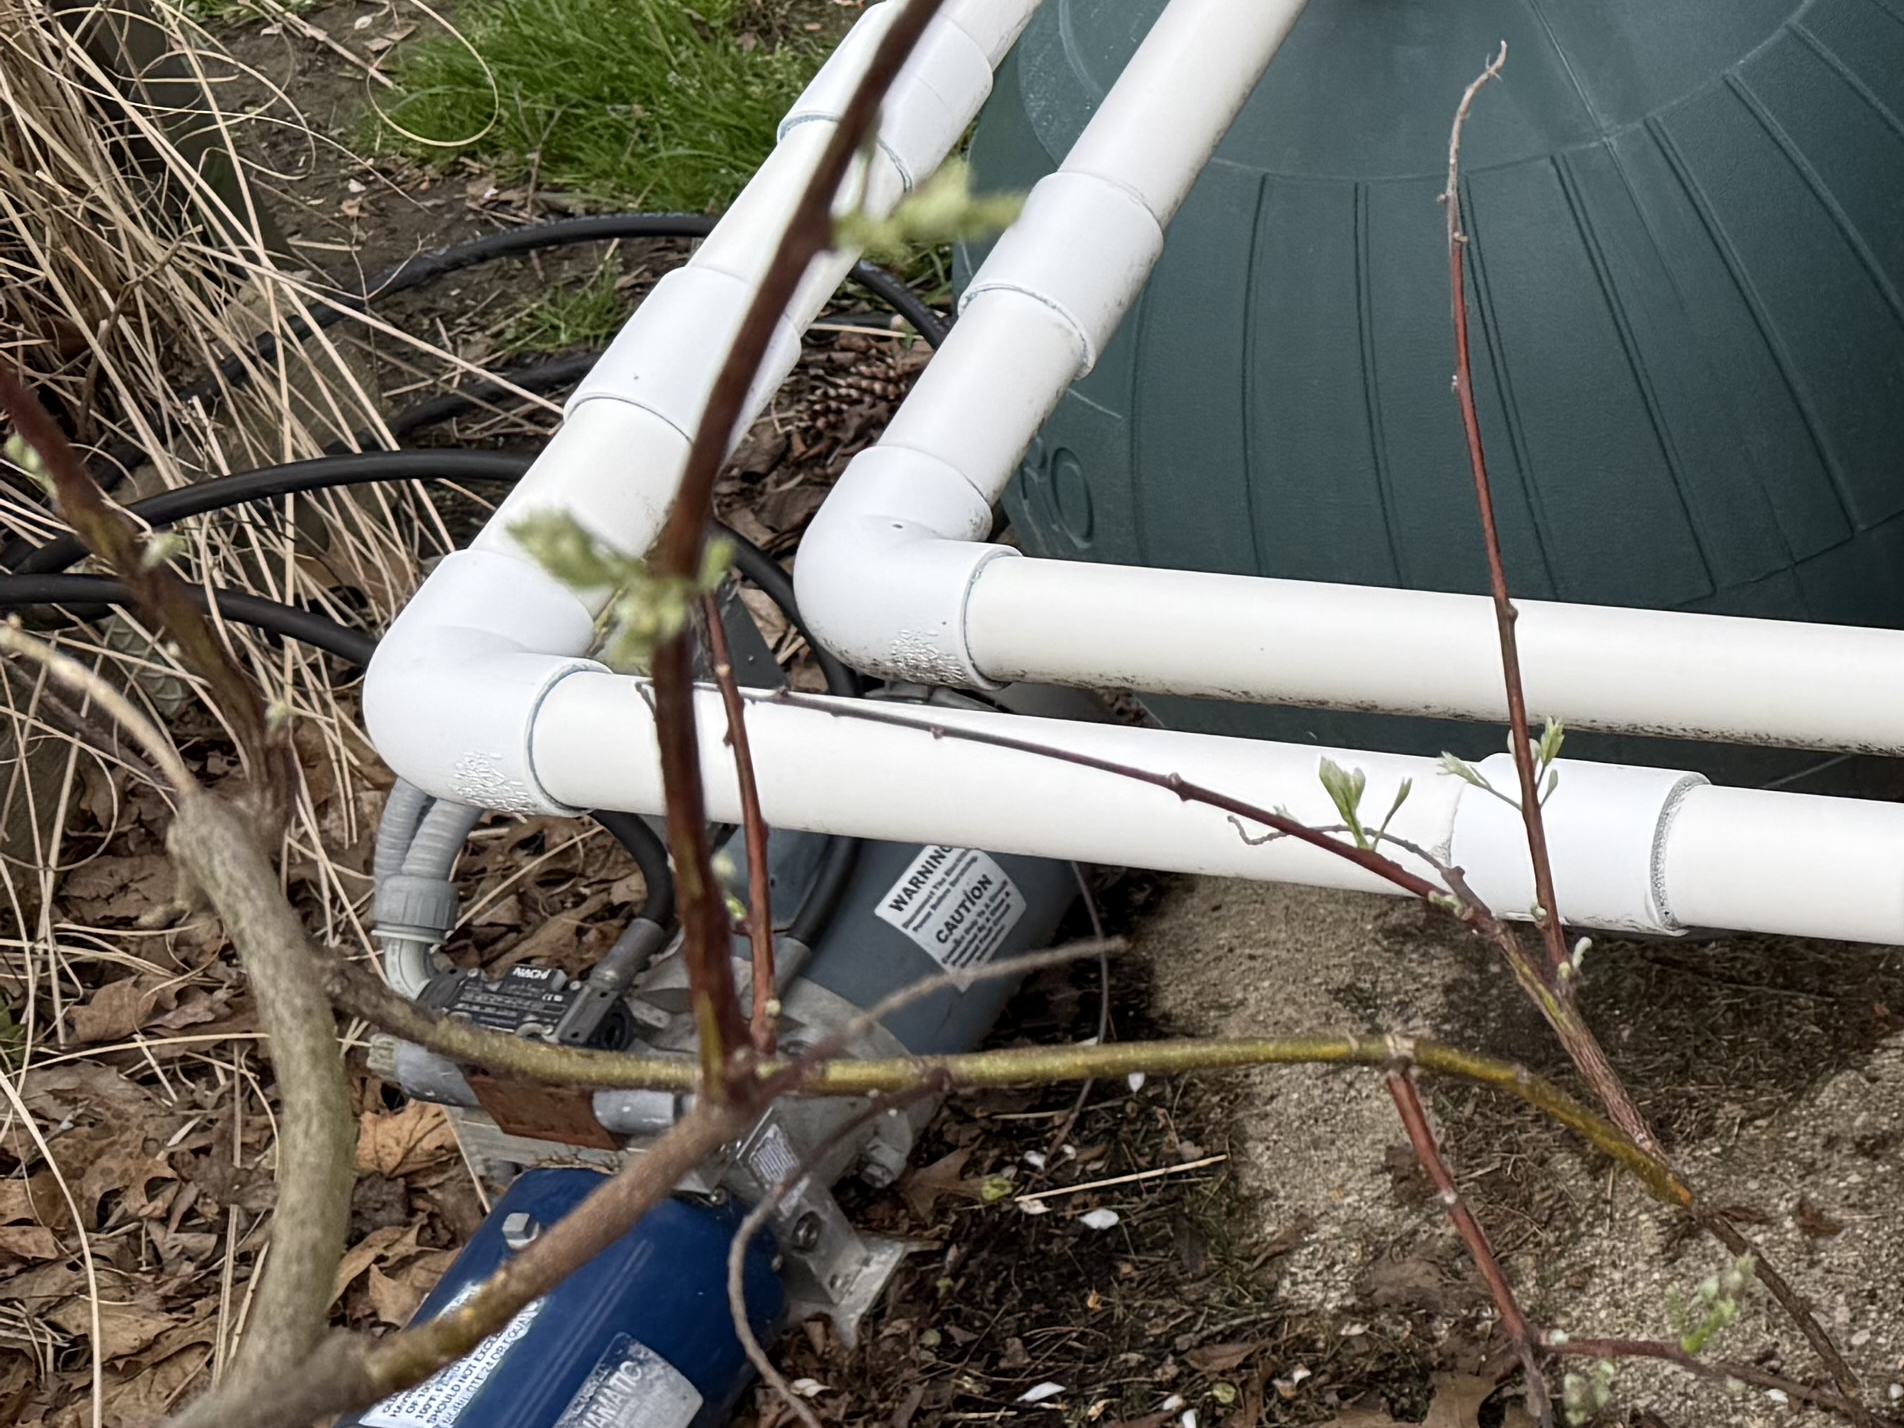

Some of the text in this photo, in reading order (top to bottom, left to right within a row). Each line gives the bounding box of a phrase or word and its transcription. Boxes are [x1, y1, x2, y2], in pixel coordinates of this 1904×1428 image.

[936, 874, 993, 944] CAUTION
[425, 1381, 461, 1427] SHOULD
[458, 1362, 476, 1384] NOT
